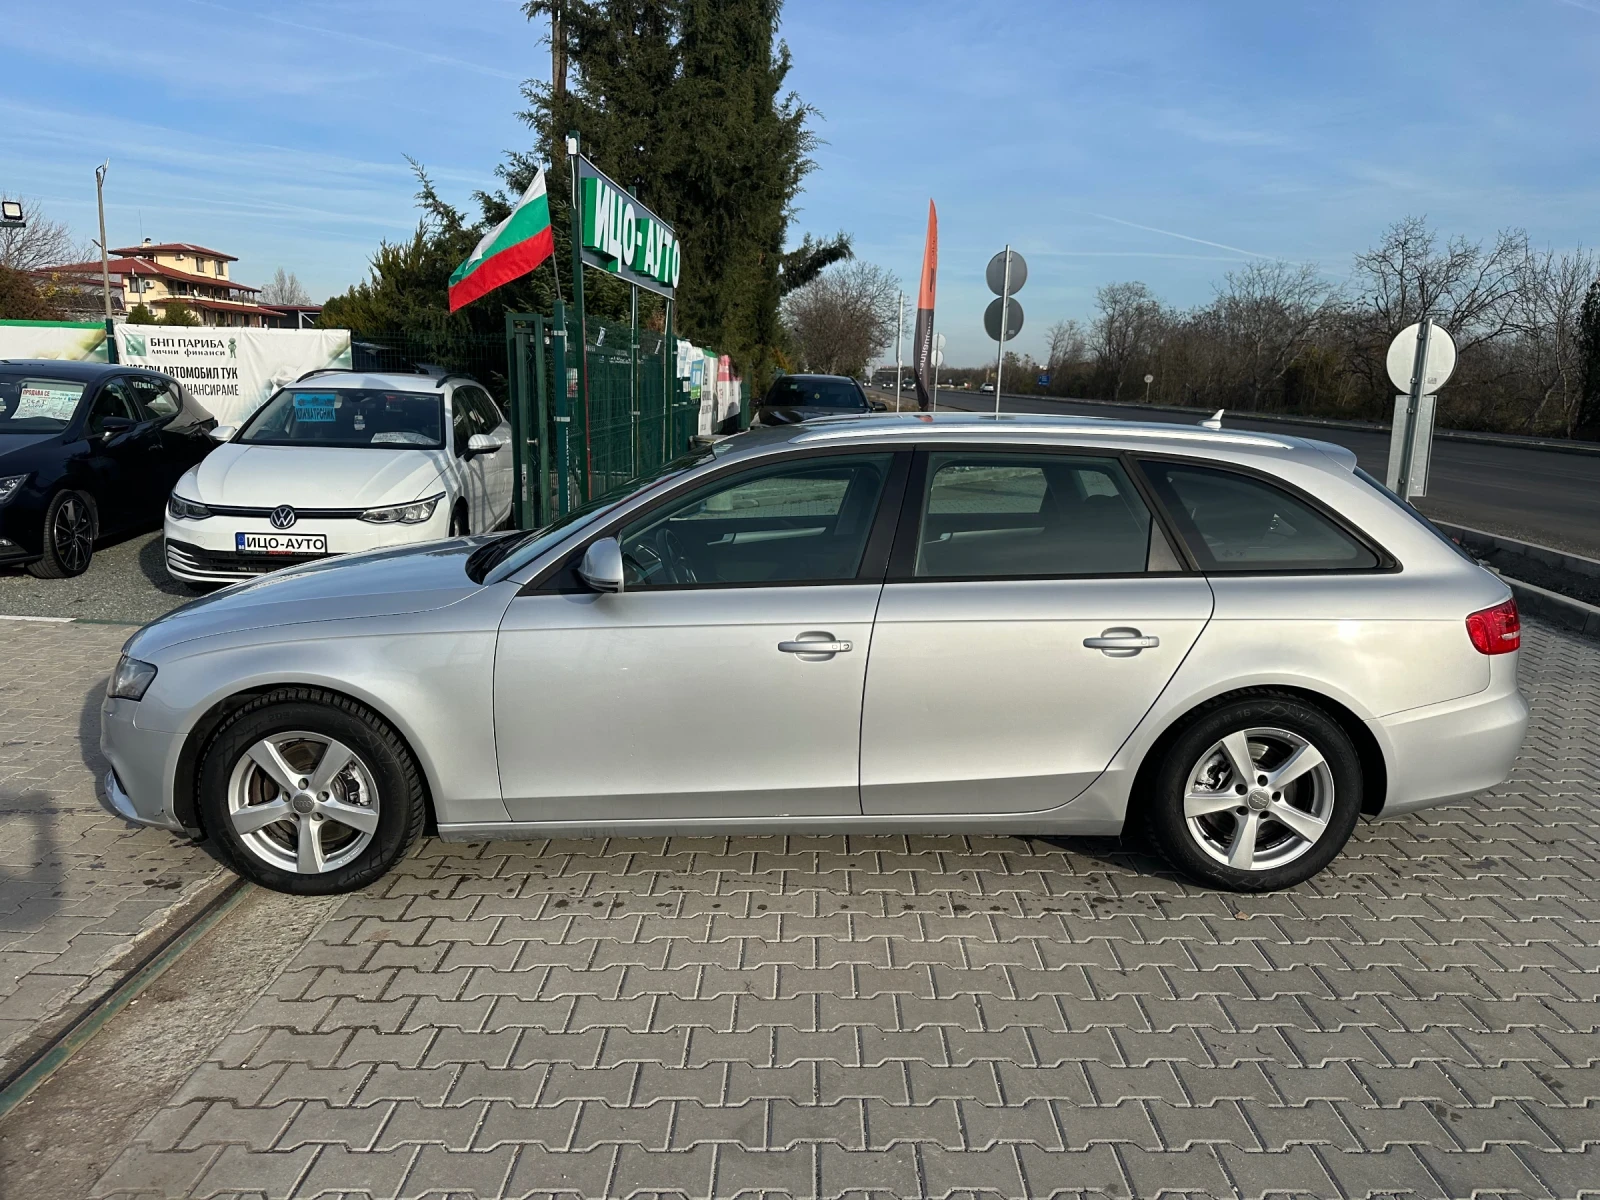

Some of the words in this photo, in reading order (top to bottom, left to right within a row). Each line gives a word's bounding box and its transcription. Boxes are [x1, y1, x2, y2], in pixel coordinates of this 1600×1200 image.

[594, 178, 680, 288] ИЦО-АУТО
[150, 338, 174, 347] БНП
[178, 338, 224, 348] ПАРИБА
[184, 349, 226, 358] финанси
[163, 366, 219, 379] АВТОМОБИЛ
[220, 367, 238, 379] ТУК
[246, 537, 324, 550] ИЦО-АУТО
